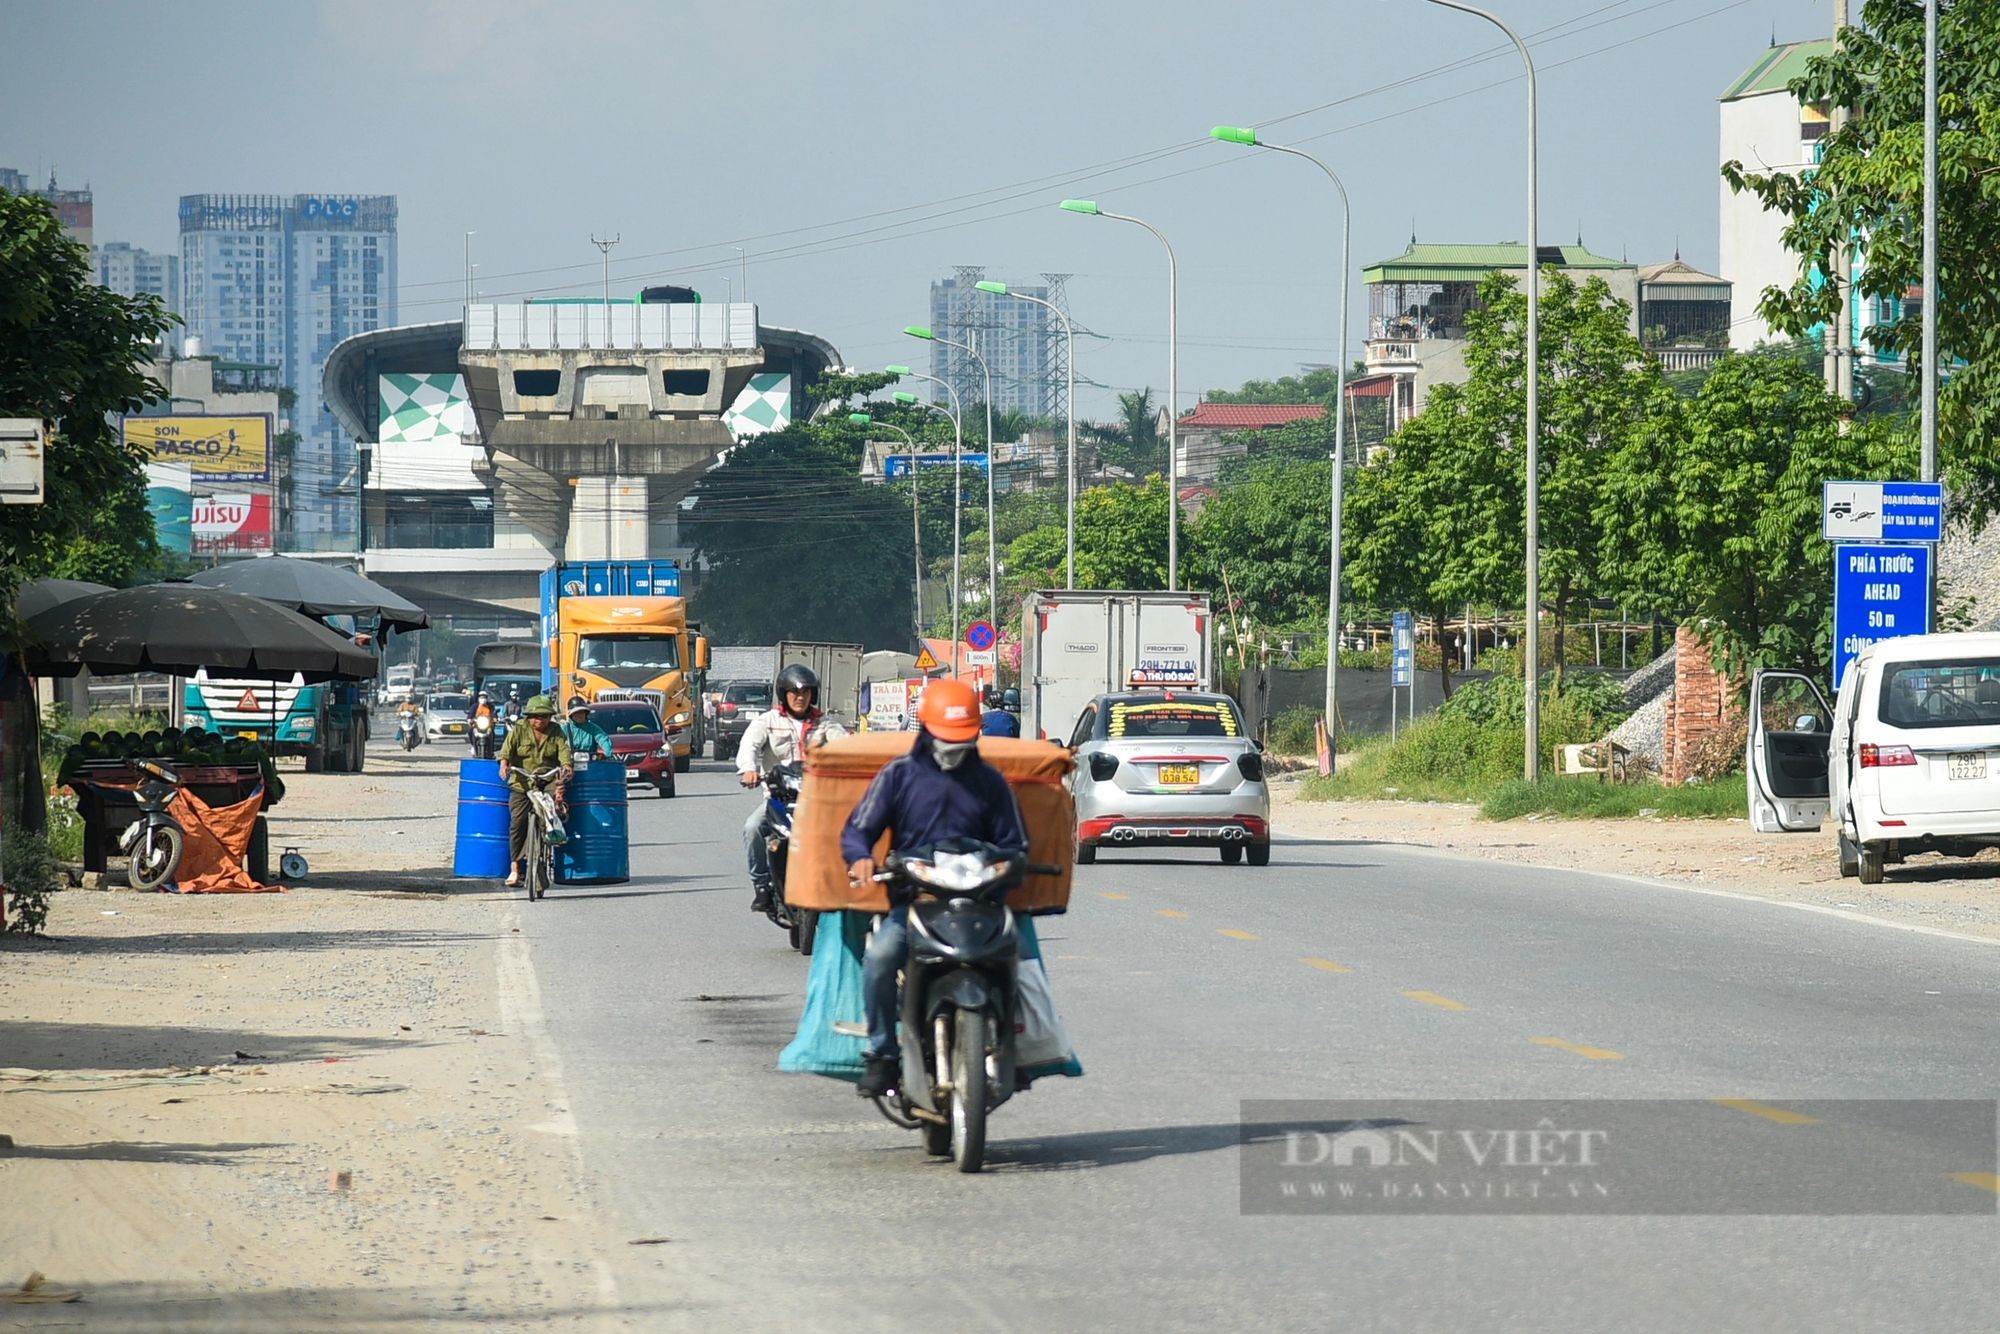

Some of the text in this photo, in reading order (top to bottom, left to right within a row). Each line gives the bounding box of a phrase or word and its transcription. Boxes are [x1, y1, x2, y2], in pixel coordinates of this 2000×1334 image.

[306, 203, 354, 217] FLC
[155, 439, 221, 456] PASCO
[1896, 515, 1905, 526] RA
[1906, 516, 1916, 526] TAI
[1850, 552, 1914, 573] PHÍA TRƯỚC
[1864, 583, 1901, 601] AHEAD
[1868, 611, 1895, 628] 50 m
[1179, 672, 1195, 681] SAO
[1956, 754, 1977, 766] 29D
[1170, 764, 1188, 774] 30E
